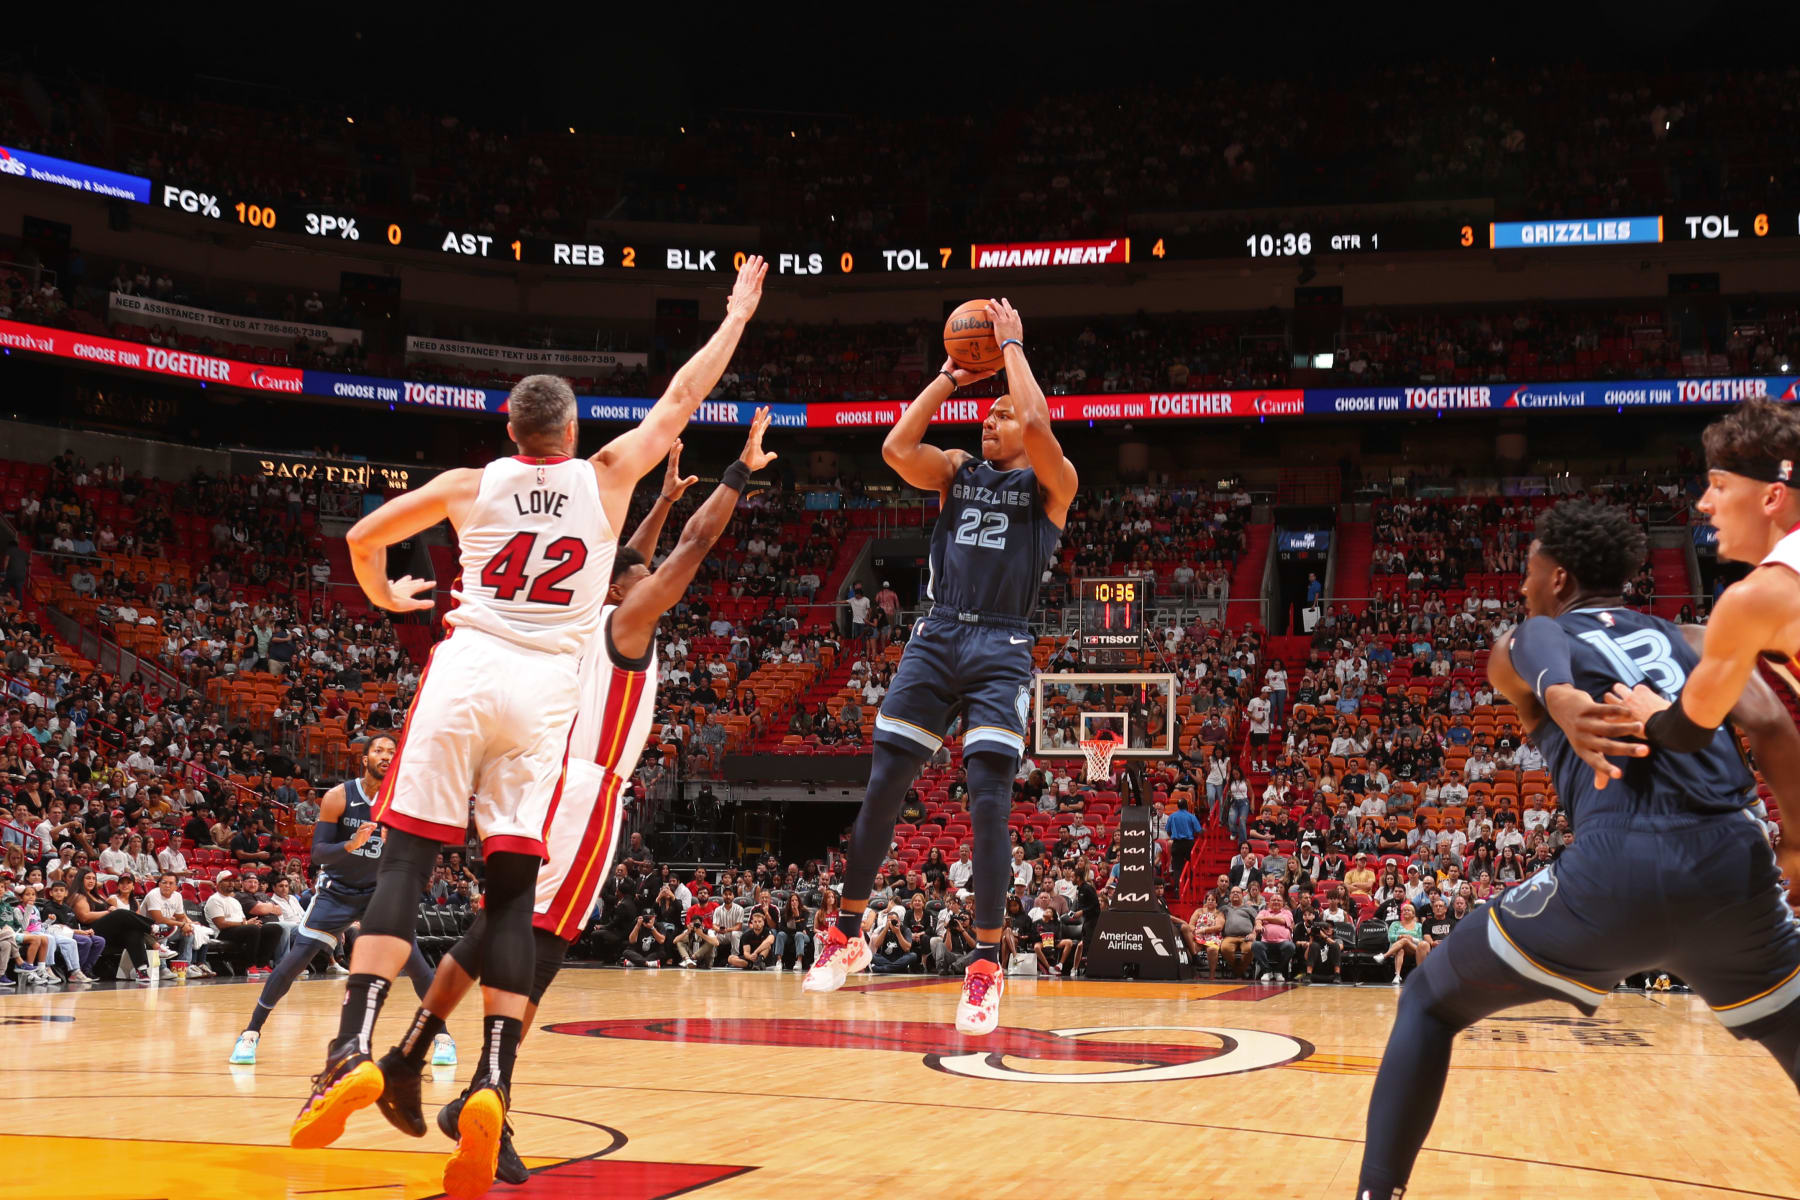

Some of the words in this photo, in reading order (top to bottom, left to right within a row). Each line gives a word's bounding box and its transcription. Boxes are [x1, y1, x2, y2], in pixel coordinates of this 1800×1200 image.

[30, 168, 83, 191] Technology
[92, 181, 136, 201] Solutions
[163, 185, 221, 219] FG%
[236, 202, 276, 229] 100
[305, 213, 359, 241] 3P%
[387, 223, 401, 245] 0
[441, 232, 493, 257] AST
[511, 241, 521, 261] 1
[553, 243, 605, 266] REB
[621, 246, 636, 268] 2
[667, 248, 716, 271] BLK
[779, 253, 821, 275] FLS
[840, 252, 853, 273] 0
[882, 250, 929, 271] TOL
[939, 248, 952, 268] 7
[1461, 226, 1474, 246] 3
[1521, 220, 1631, 243] GRIZZLIES
[1685, 215, 1739, 238] TOL
[1753, 213, 1768, 236] 6
[979, 249, 1050, 268] MIAMI
[1052, 240, 1117, 265] HEAT
[1152, 239, 1165, 258] 4
[1247, 232, 1311, 257] 10:36
[1331, 234, 1360, 250] QTR
[1371, 233, 1378, 250] 1
[115, 297, 141, 310] NEED
[143, 301, 205, 322] ASSISTANCE?
[207, 314, 230, 327] TEXT
[233, 318, 246, 329] US
[248, 321, 260, 331] AT
[73, 342, 117, 362] CHOOSE
[118, 350, 141, 367] FUN
[145, 347, 230, 381] TOGETHER
[412, 341, 437, 351] NEED
[439, 343, 499, 358] ASSISTANCE?
[502, 350, 525, 361] TEXT
[527, 352, 539, 361] US
[541, 353, 552, 361] AT
[334, 382, 375, 400] CHOOSE
[377, 387, 398, 402] FUN
[403, 381, 487, 410] TOGETHER
[1335, 397, 1375, 411] CHOOSE
[1378, 396, 1399, 410] FUN
[1404, 386, 1492, 409] TOGETHER
[1520, 391, 1585, 408] Carnival
[1604, 390, 1646, 405] CHOOSE
[1649, 389, 1671, 404] FUN
[1677, 379, 1768, 402] TOGETHER
[591, 405, 630, 420] CHOOSE
[836, 410, 873, 425] CHOOSE
[875, 410, 894, 424] FUN
[1082, 404, 1121, 418] CHOOSE
[1123, 403, 1144, 417] FUN
[1149, 393, 1232, 415] TOGETHER
[514, 490, 569, 518] LOVE
[952, 483, 1031, 507] GRIZZLIES
[954, 507, 1009, 550] 22
[1290, 538, 1316, 549] Kaseya
[481, 531, 588, 606] 42
[1095, 583, 1135, 602] 10:36
[1105, 602, 1130, 629] 11
[1098, 635, 1139, 644] TISSOT
[1099, 931, 1144, 941] American
[1107, 941, 1143, 951] Airlines
